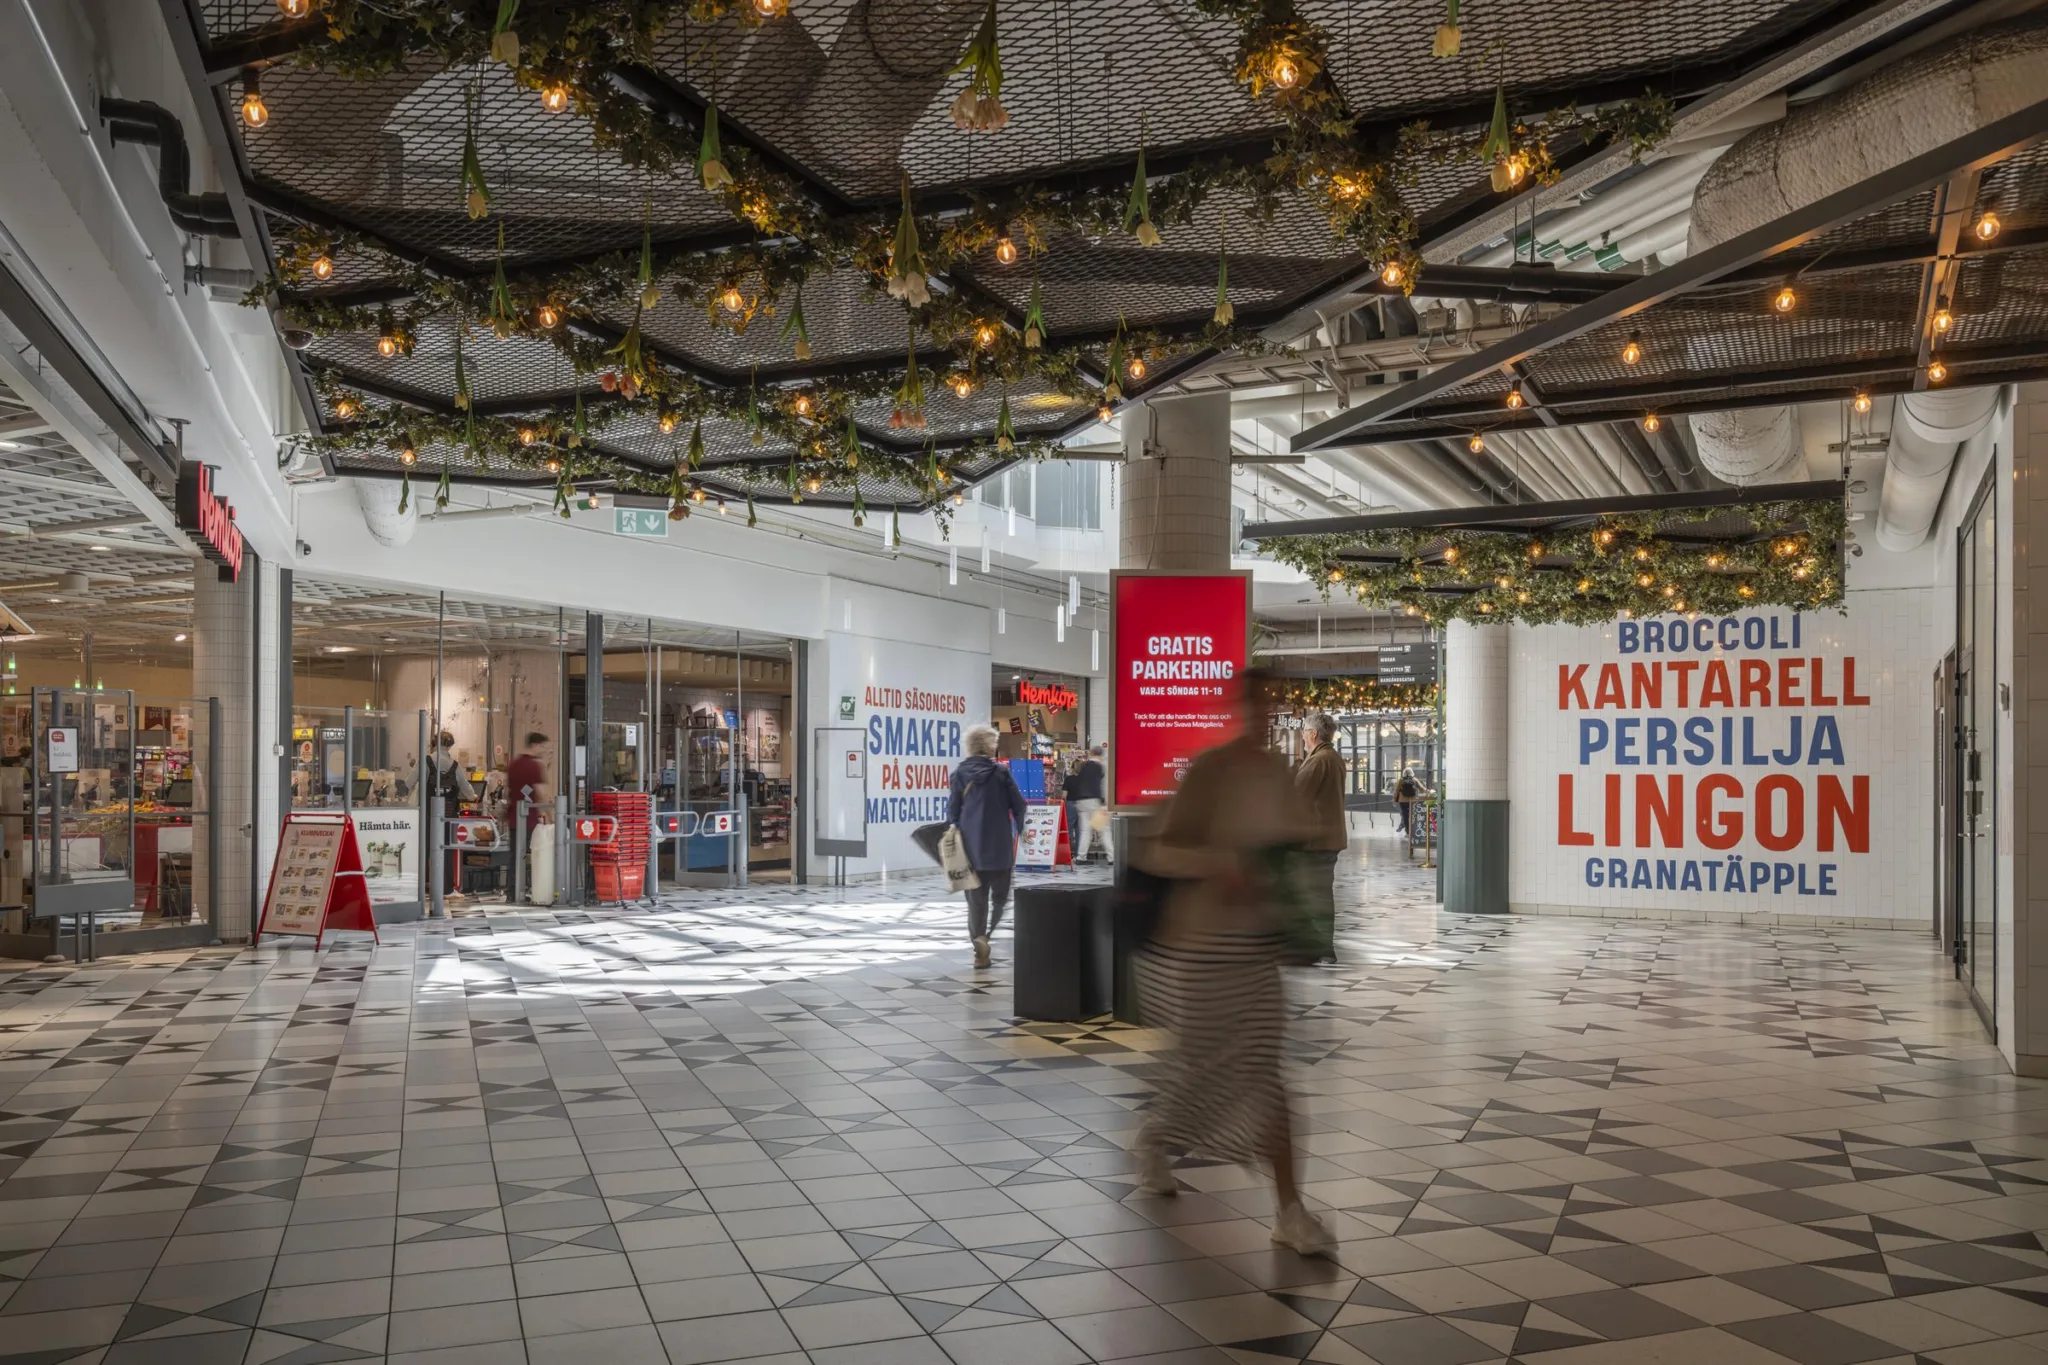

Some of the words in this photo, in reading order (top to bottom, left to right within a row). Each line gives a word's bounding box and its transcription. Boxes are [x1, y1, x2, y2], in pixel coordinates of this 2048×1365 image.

[199, 460, 243, 584] Hemköp
[1148, 636, 1213, 655] GRATIS
[1619, 614, 1801, 654] BROCCOLI
[1132, 660, 1234, 680] PARKERING
[1559, 656, 1871, 710] KANTARELL
[865, 686, 902, 709] ALLTID
[905, 687, 966, 714] SÄSONGENS
[1019, 679, 1078, 712] Hemköp
[1140, 687, 1165, 695] VARJE
[1167, 685, 1199, 696] SÖNDAG
[1201, 687, 1223, 695] 11-18
[869, 714, 961, 758] SMAKER
[1579, 715, 1845, 766] PERSILJA
[882, 758, 901, 790] PÅ
[905, 764, 950, 790] SVAVA
[359, 821, 391, 831] Hämta
[393, 821, 411, 830] här.
[866, 796, 950, 824] MATGALLER
[1558, 773, 1870, 854] LINGON
[1585, 854, 1837, 896] GRANATÄPPLE
